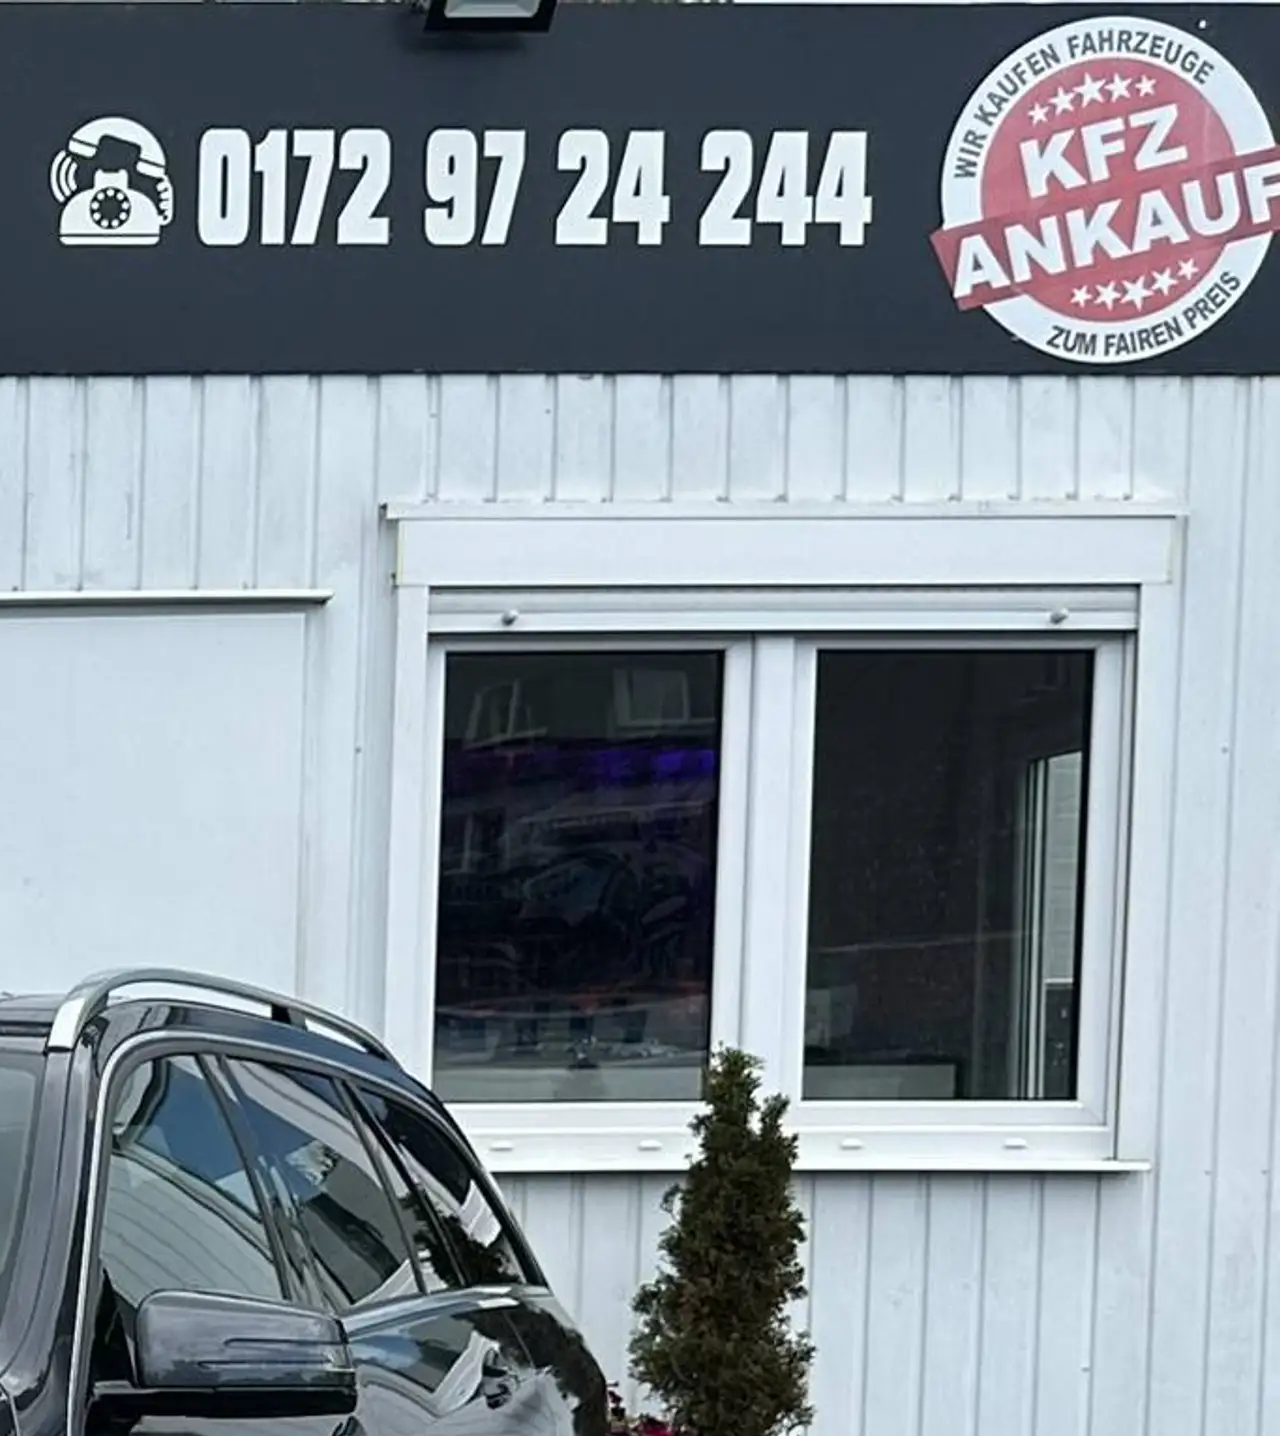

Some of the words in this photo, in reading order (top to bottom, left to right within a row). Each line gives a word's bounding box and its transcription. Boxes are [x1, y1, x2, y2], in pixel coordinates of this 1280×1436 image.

[954, 128, 988, 179] WIR
[974, 43, 1061, 127] KAUFEN
[1066, 29, 1215, 85] FAHRZEUGE
[1019, 103, 1188, 199] KFZ
[198, 127, 392, 247] 0172
[422, 128, 527, 246] 97
[555, 129, 671, 246] 24
[698, 129, 874, 247] 244
[953, 160, 1280, 299] ANKAUF
[1045, 325, 1097, 356] ZUM
[1104, 319, 1184, 357] FAIREN
[1184, 270, 1241, 331] PREIS
